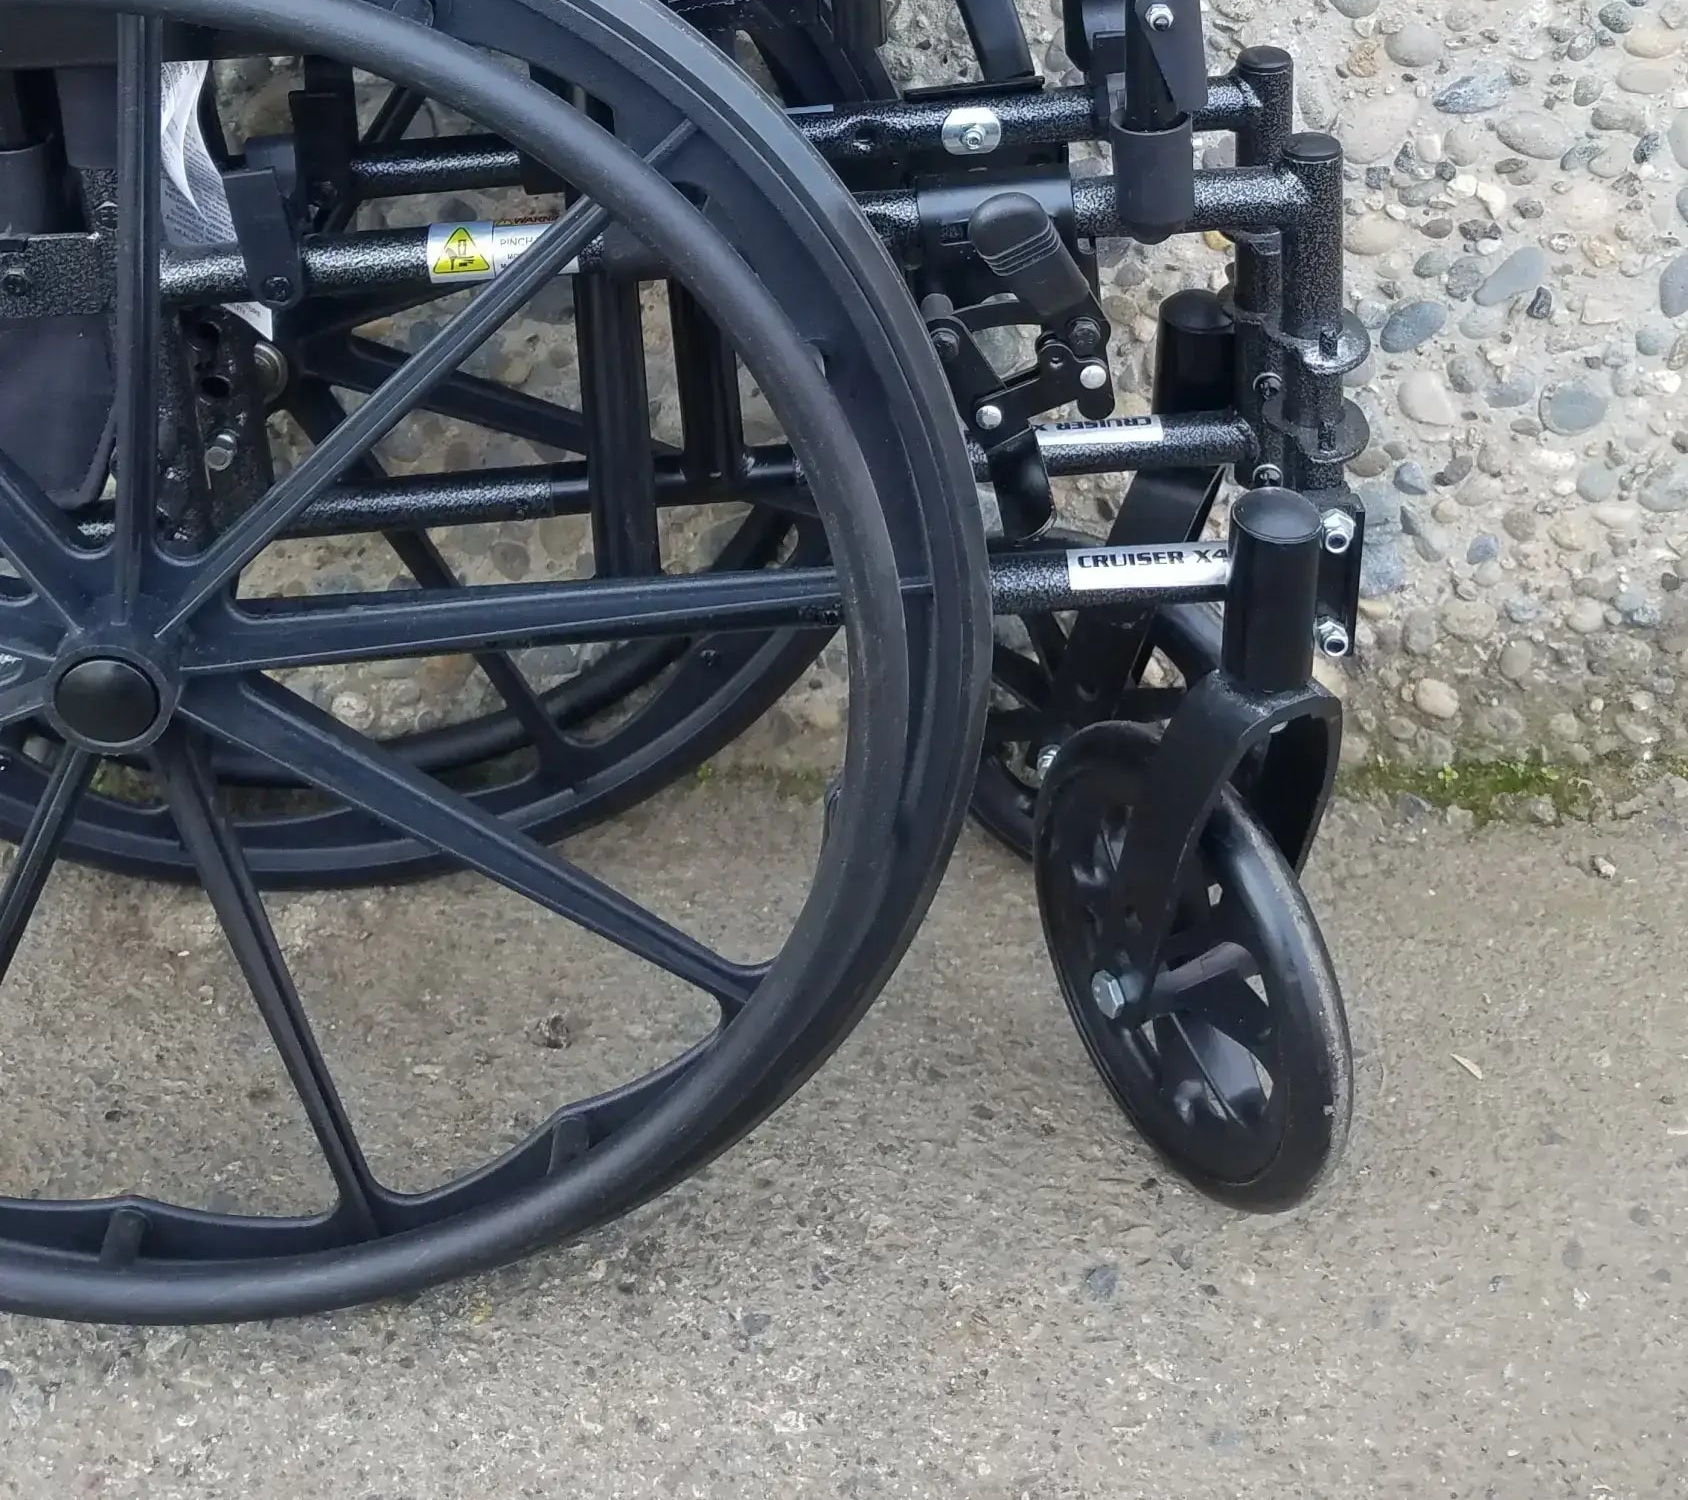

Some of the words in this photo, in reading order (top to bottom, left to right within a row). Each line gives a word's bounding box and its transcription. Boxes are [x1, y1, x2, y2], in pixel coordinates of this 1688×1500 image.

[500, 236, 533, 247] PINCH
[1055, 416, 1152, 431] CRUISER
[1077, 550, 1185, 569] CRUISER
[1191, 547, 1229, 564] X4
